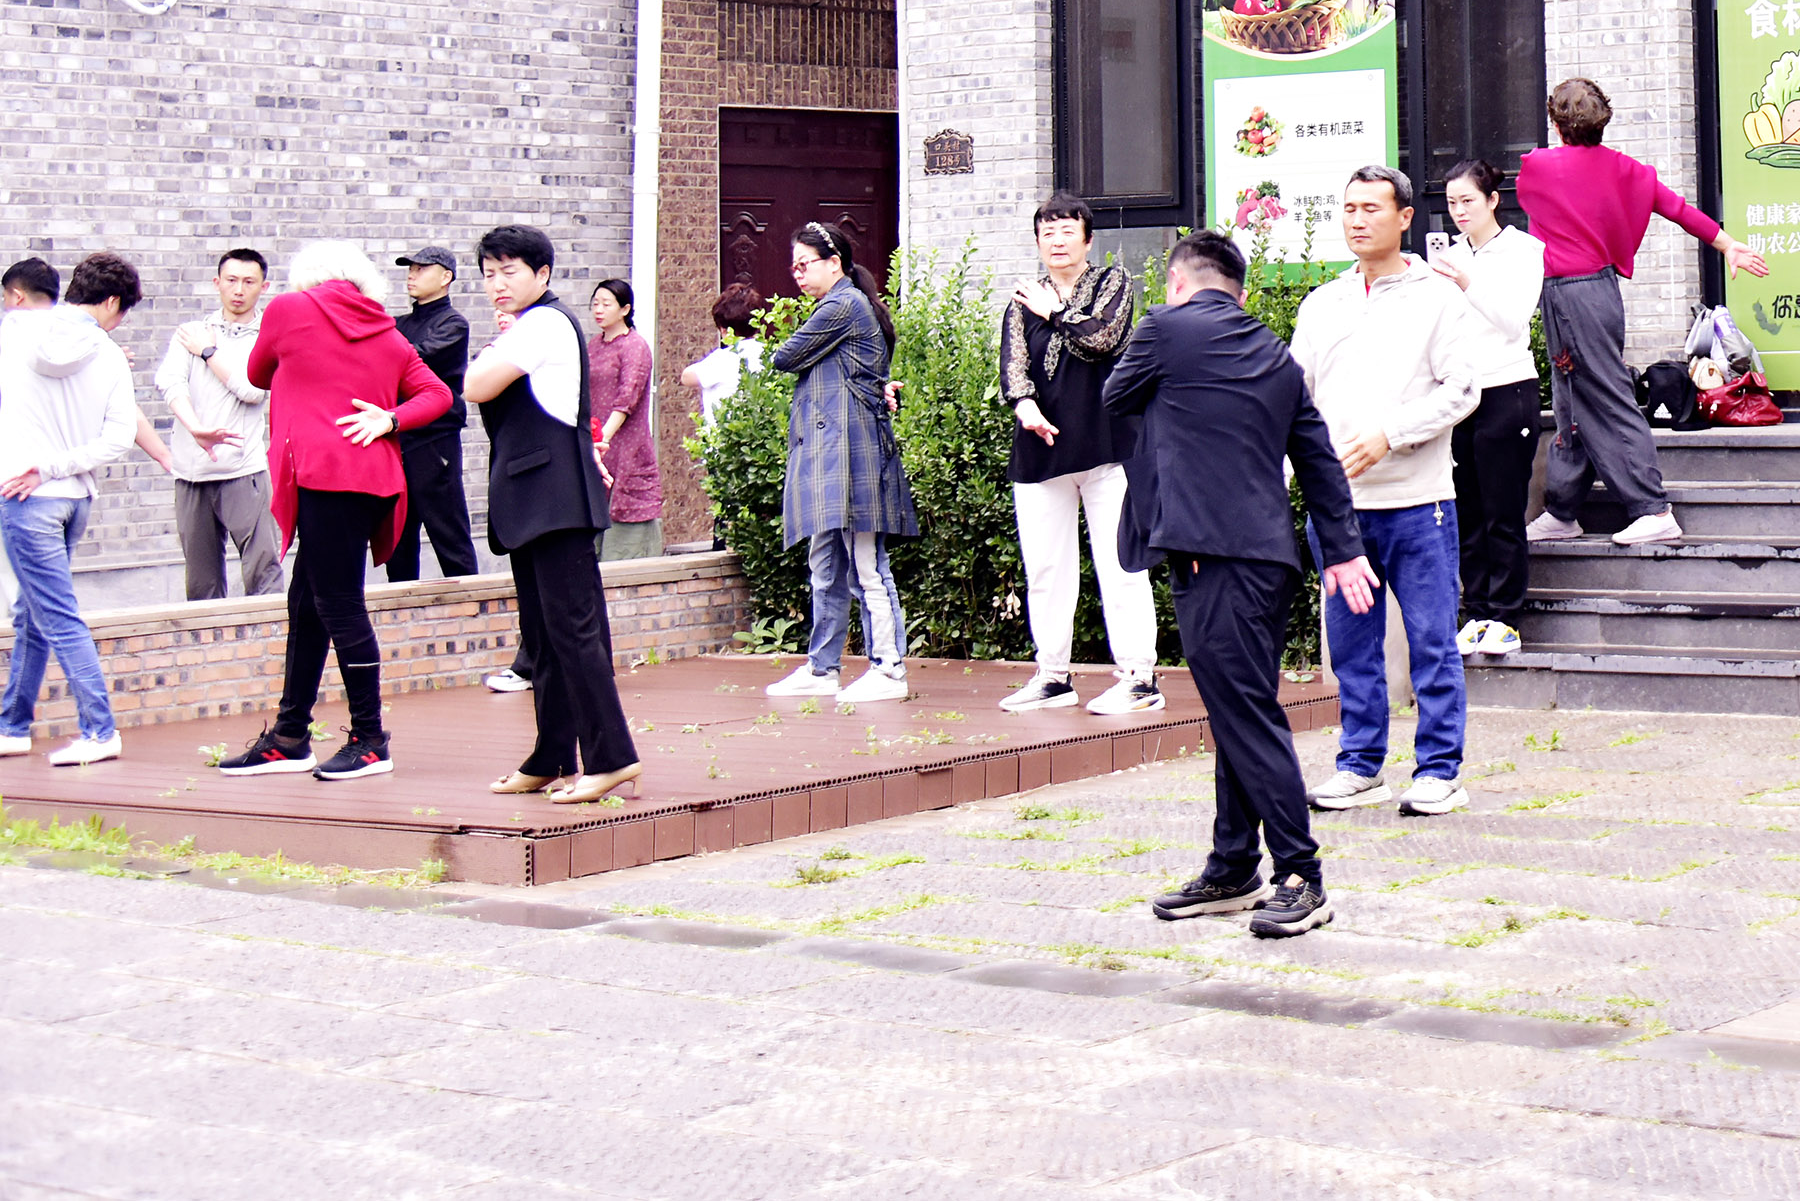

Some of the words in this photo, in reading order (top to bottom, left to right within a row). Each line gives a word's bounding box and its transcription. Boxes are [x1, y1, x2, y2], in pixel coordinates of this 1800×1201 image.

[1294, 120, 1365, 138] 各类有机蔬菜
[1294, 210, 1332, 222] 羊鱼等
